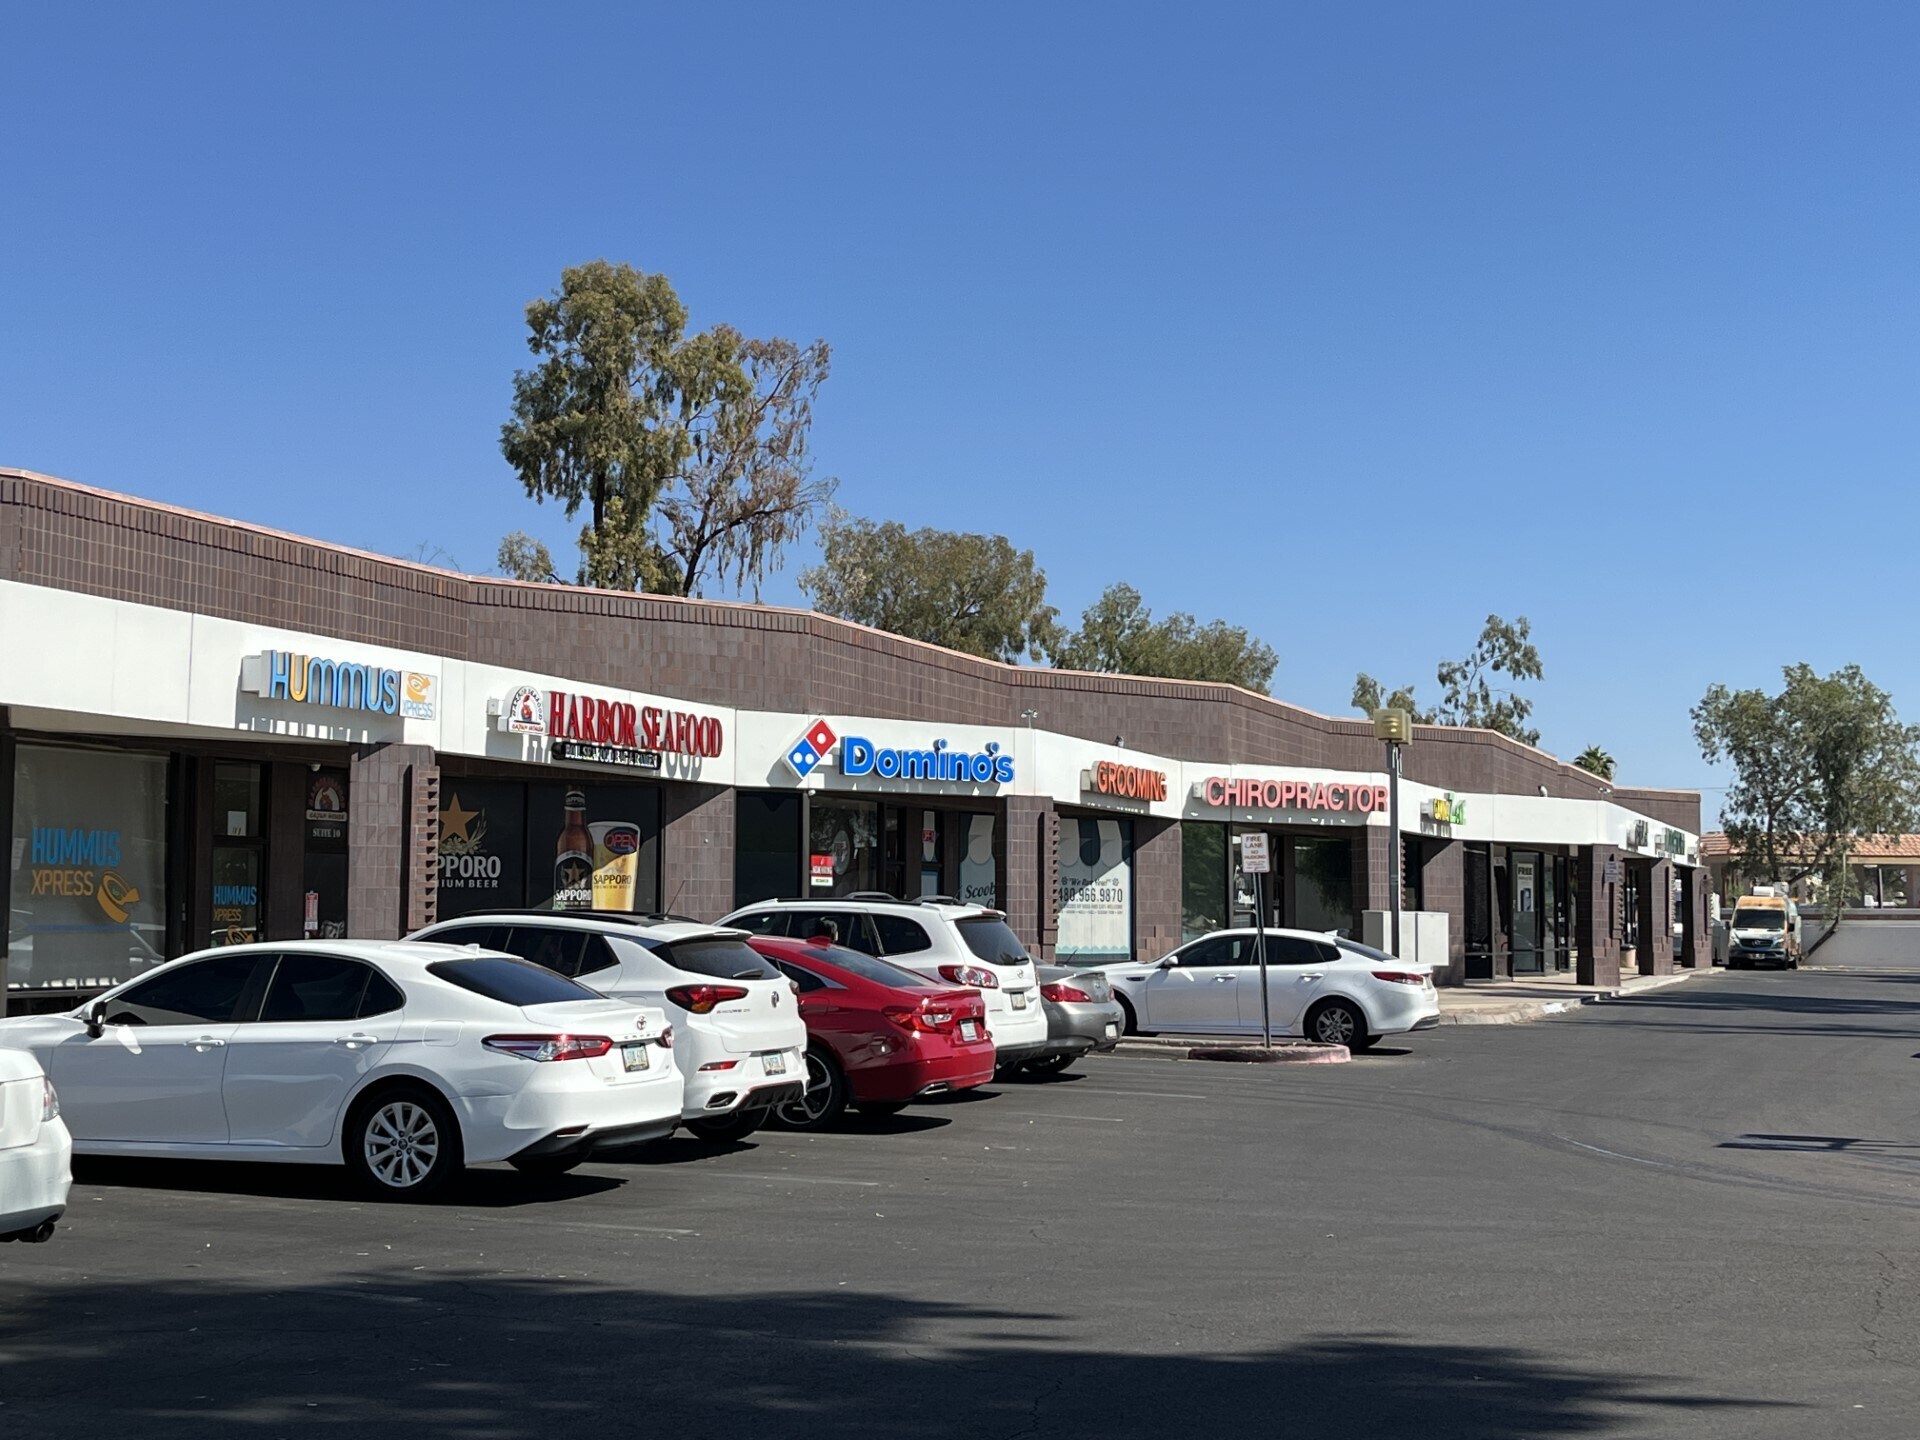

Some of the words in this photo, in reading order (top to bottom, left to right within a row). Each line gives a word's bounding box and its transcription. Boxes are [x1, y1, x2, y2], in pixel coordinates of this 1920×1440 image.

[270, 649, 398, 715] HUMMUS
[402, 701, 433, 718] XPRESS
[549, 690, 637, 748] HARBOR
[641, 705, 723, 758] SEAFOOD
[842, 736, 1014, 783] Domino's
[1097, 760, 1167, 802] GROOMING
[1206, 776, 1388, 812] CHIROPRACTOR
[312, 828, 331, 837] SUITE
[605, 834, 638, 847] OPEN
[32, 827, 121, 867] HUMMUS
[31, 869, 94, 896] XPRESS
[468, 879, 498, 888] BEER
[593, 874, 632, 885] SAPPORO
[213, 885, 257, 905] HUMMUS
[555, 889, 592, 901] SAPPORO
[1059, 887, 1123, 902] 480.966.9870
[213, 908, 242, 922] XPRESS
